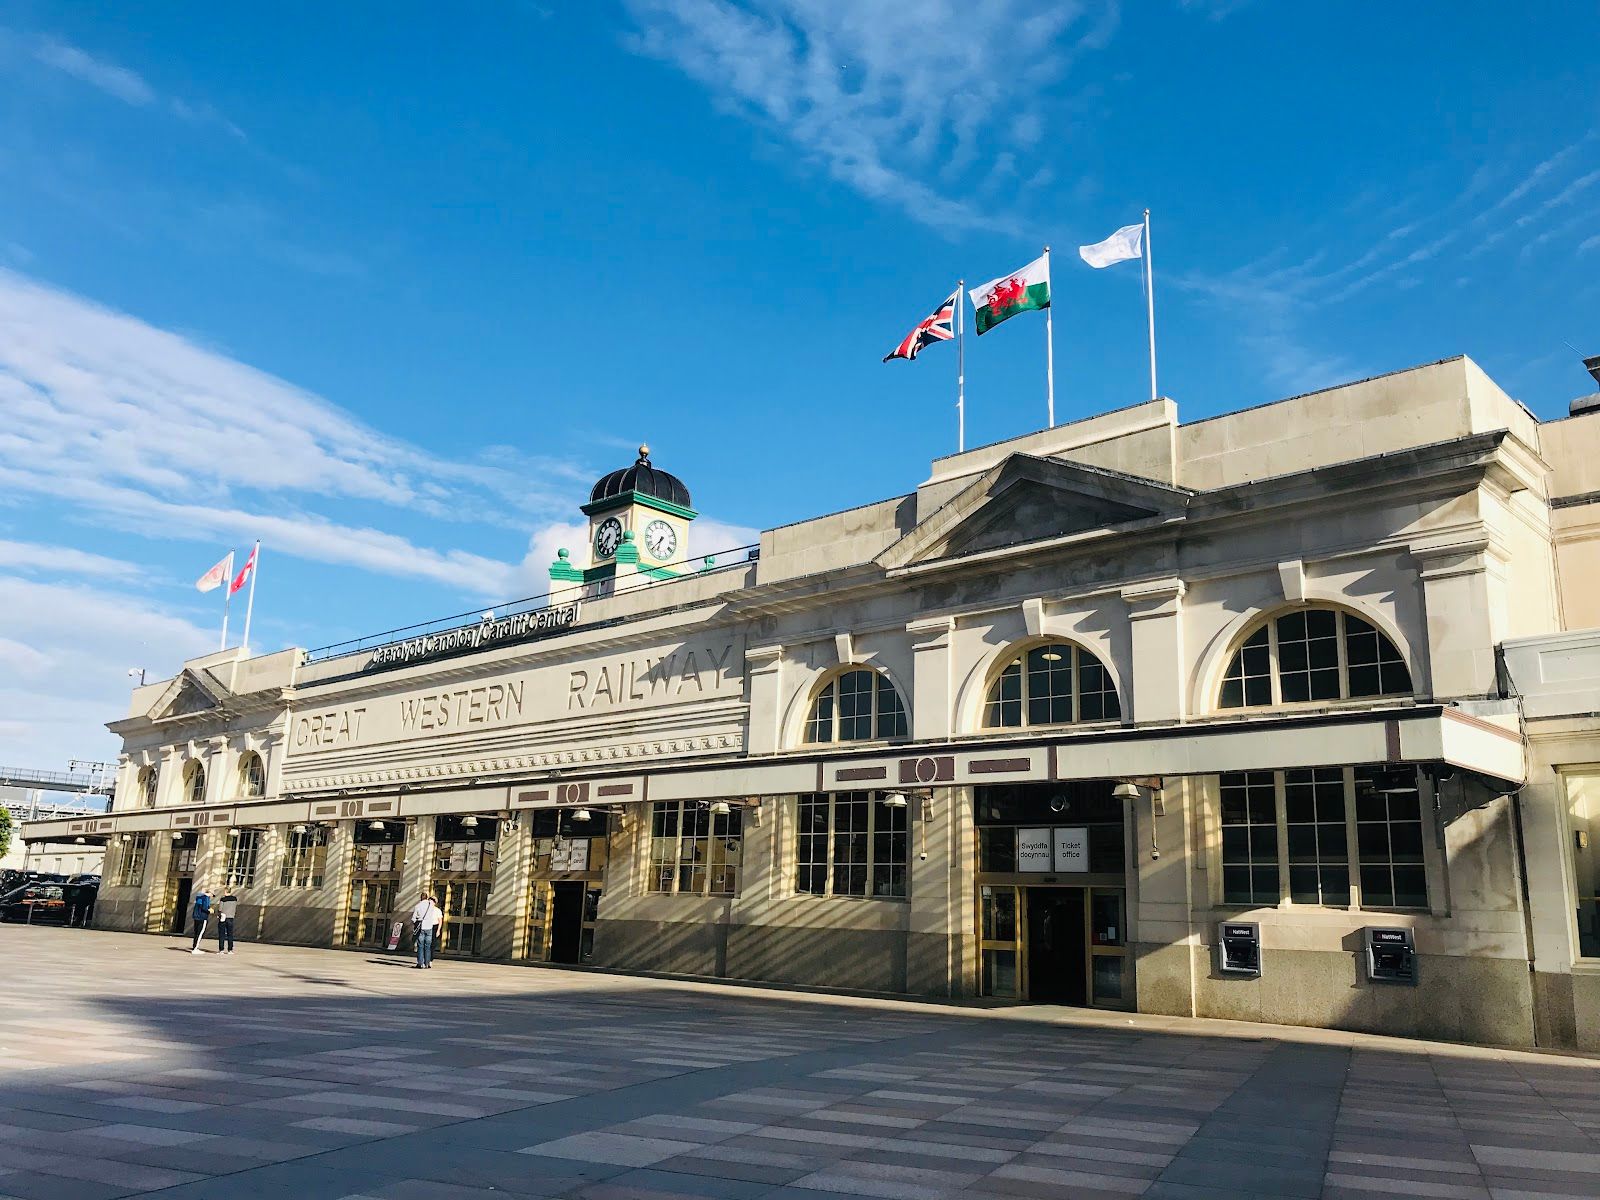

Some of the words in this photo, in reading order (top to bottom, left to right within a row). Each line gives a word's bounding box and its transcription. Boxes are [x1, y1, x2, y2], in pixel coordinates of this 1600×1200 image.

[529, 602, 582, 630] Central
[296, 708, 366, 747] GREAT
[400, 680, 524, 732] WESTERN
[568, 644, 733, 710] RAILWAY
